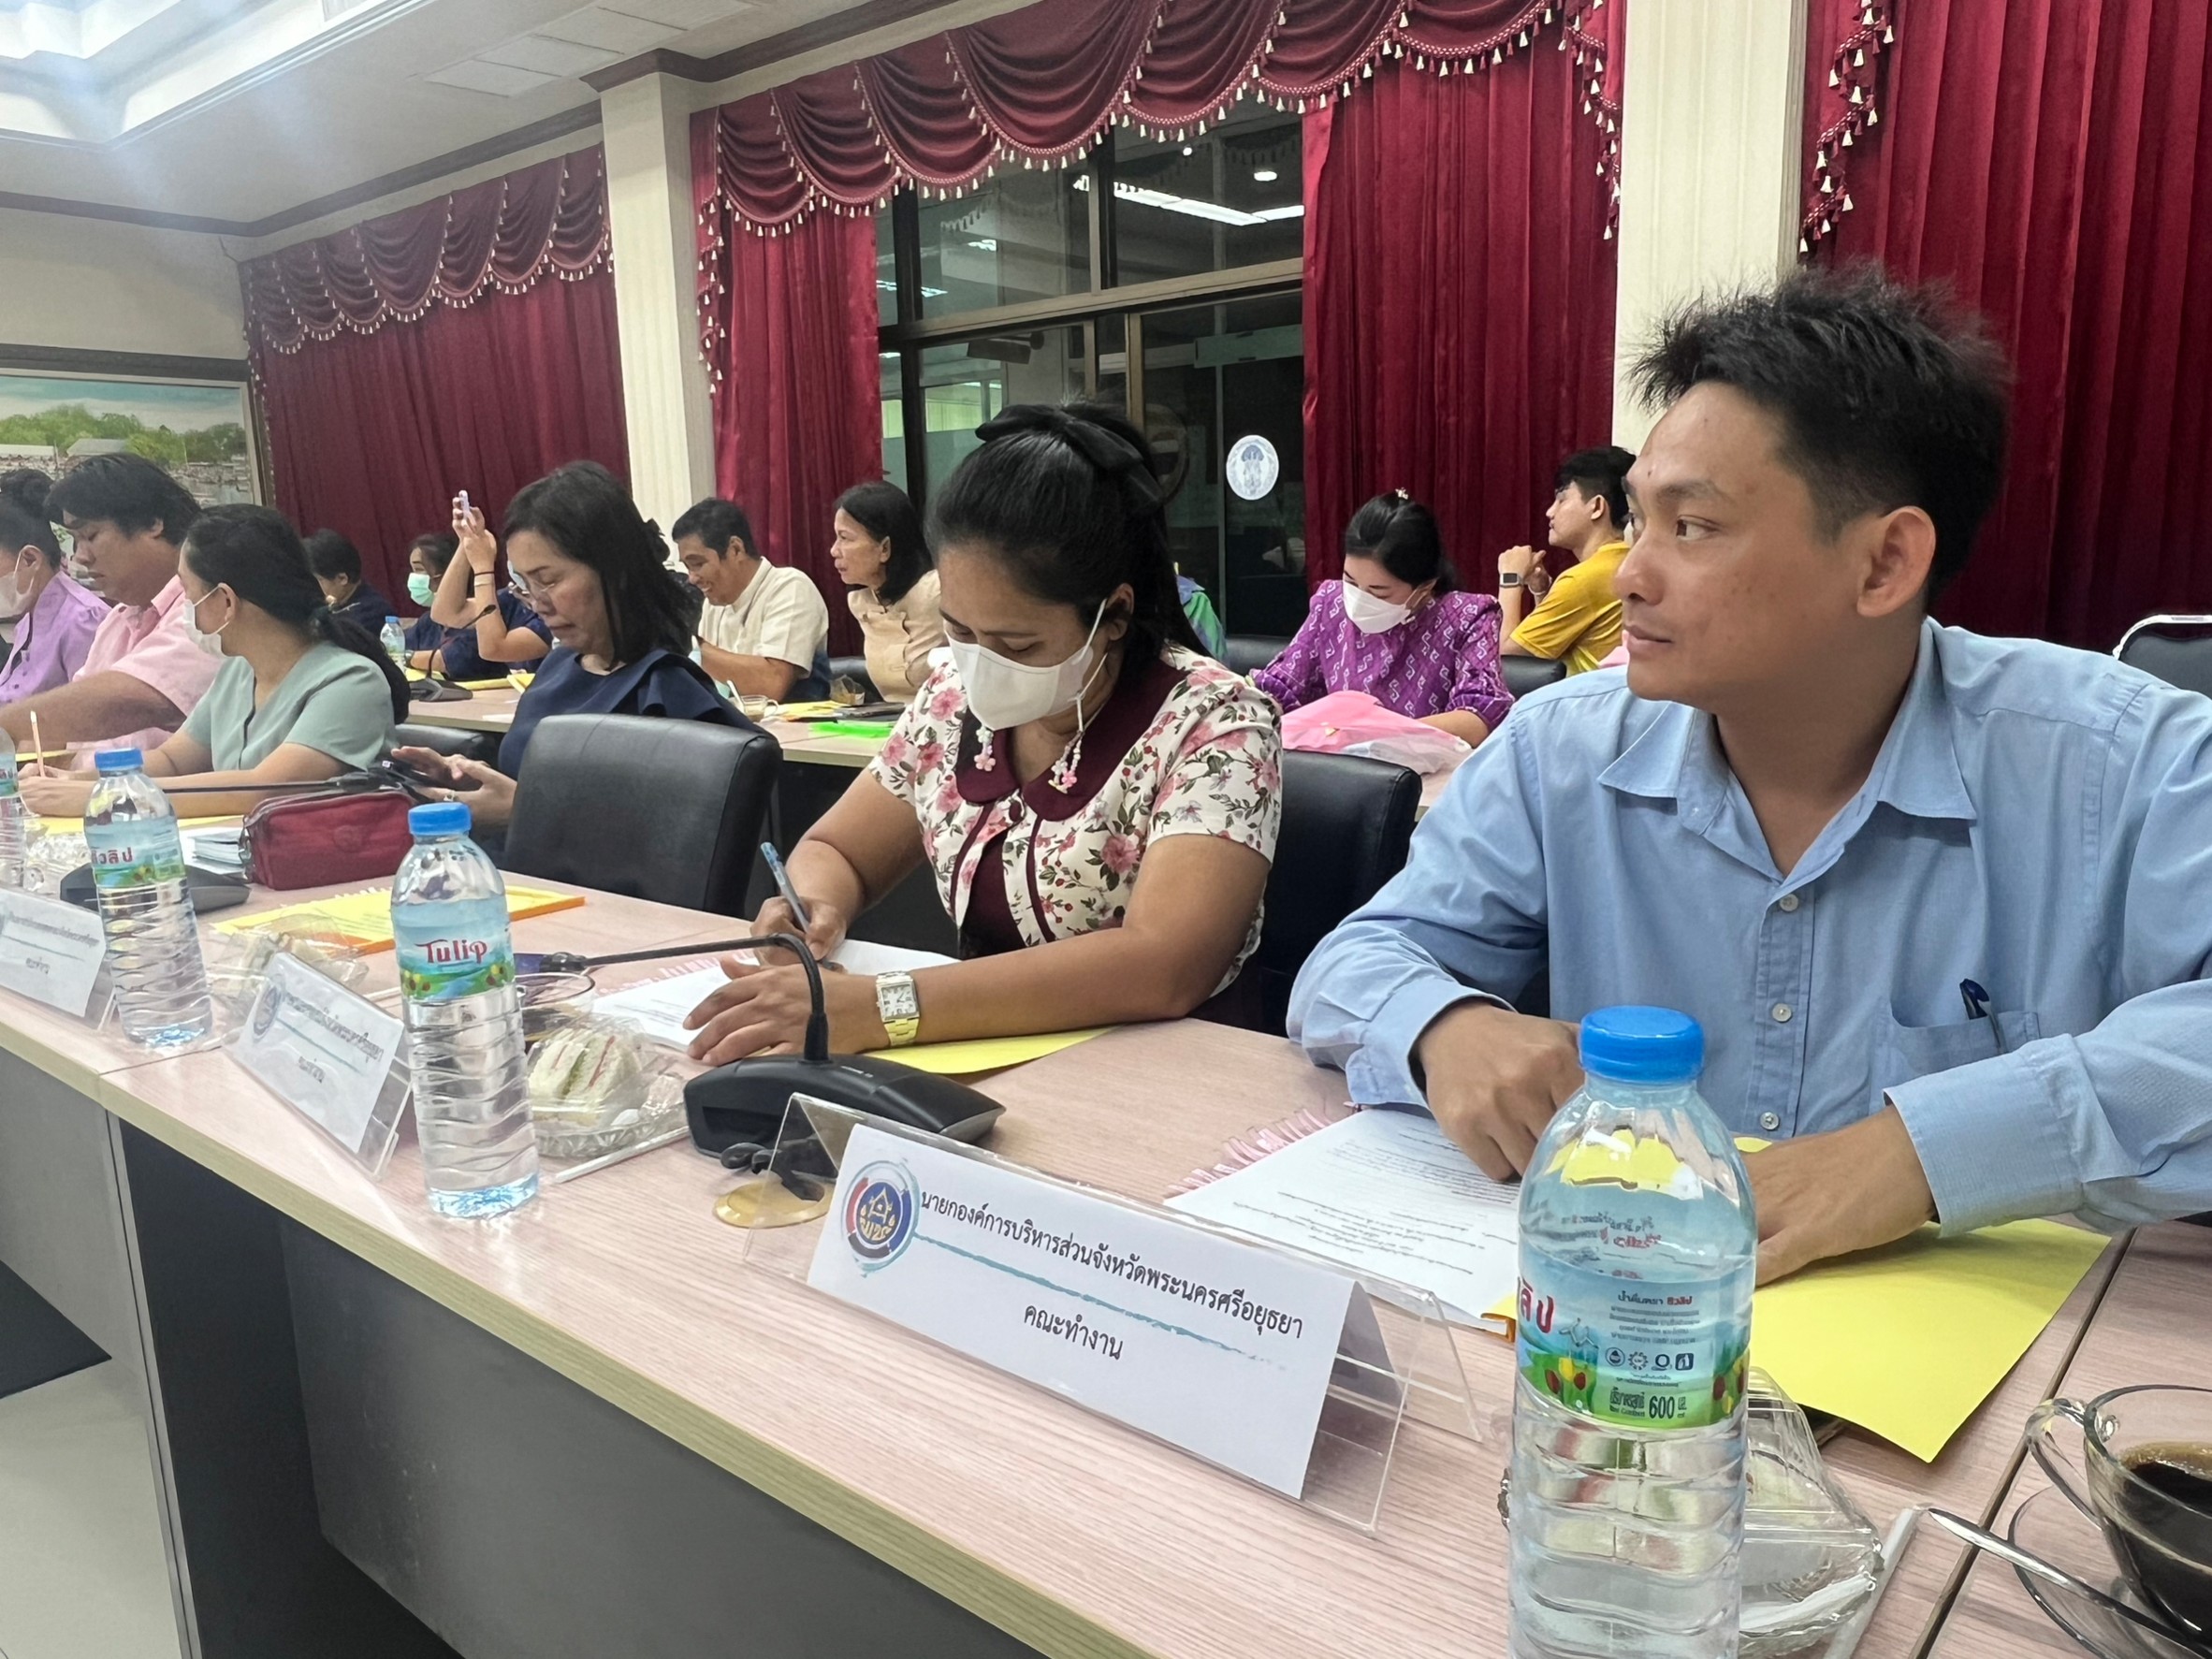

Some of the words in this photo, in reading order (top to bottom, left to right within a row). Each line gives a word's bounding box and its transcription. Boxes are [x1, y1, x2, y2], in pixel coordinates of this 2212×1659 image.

[415, 939, 488, 965] Tulip
[921, 1190, 1303, 1340] นายกองค์การบริหารส่วนจังหวัดพระนครศรีอยุธยา
[1024, 1304, 1124, 1361] คณะทำงาน
[1517, 1276, 1554, 1334] ลิป
[1649, 1395, 1675, 1419] 600
